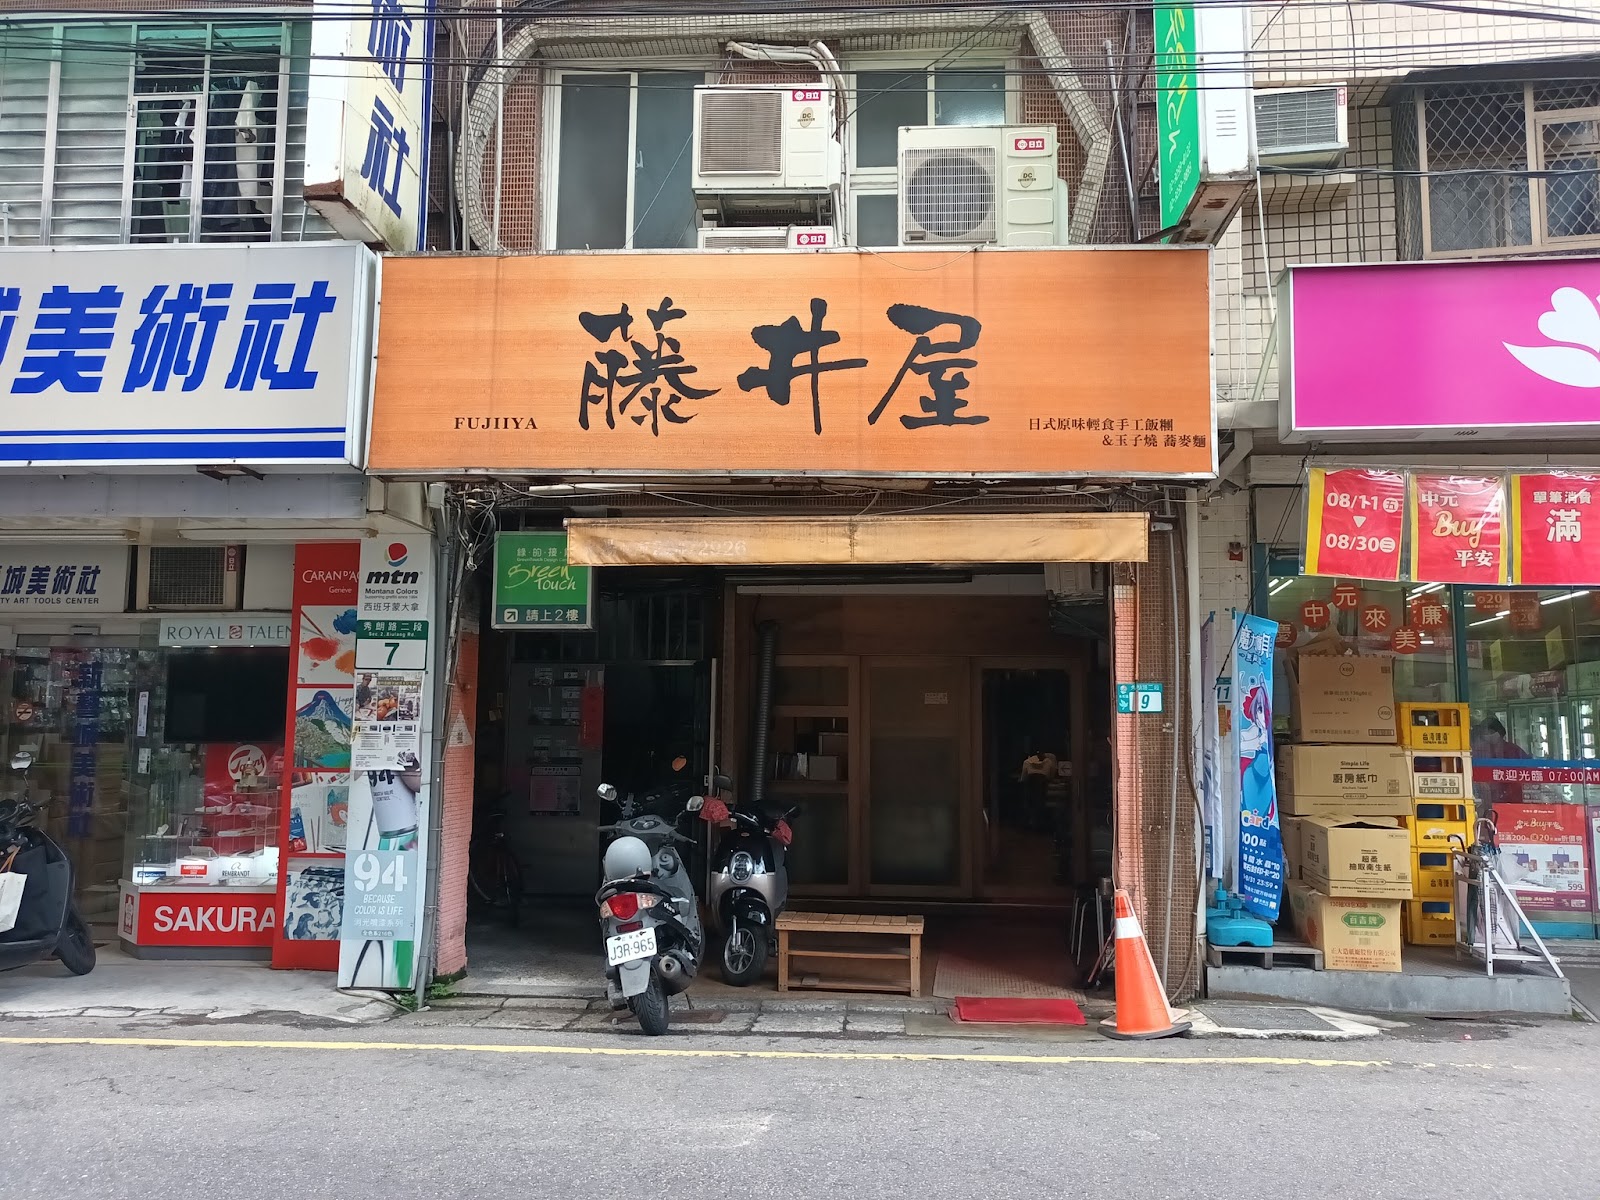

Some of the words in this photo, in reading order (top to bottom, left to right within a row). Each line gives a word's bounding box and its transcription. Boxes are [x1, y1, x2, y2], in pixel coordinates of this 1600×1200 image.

[0, 281, 337, 394] 美術社
[580, 297, 990, 435] 藤井屋
[454, 416, 538, 430] FUJIIYA
[1028, 417, 1174, 432] 日式原味輕食手工飯糰
[1421, 490, 1459, 507] 中元
[1533, 489, 1592, 504] 單筆消費
[1432, 510, 1486, 548] Buy
[1546, 508, 1582, 543] 滿
[1454, 549, 1494, 567] 平安
[0, 565, 101, 595] 城美術社
[366, 570, 419, 584] mtn
[534, 576, 577, 590] Touch
[363, 602, 420, 612] 西班牙蒙大拿
[526, 609, 579, 622] 請上2樓
[166, 626, 225, 640] ROYAL
[363, 621, 423, 631] 秀朗路二段
[384, 642, 400, 666] 7
[1216, 686, 1230, 700] 11
[1141, 694, 1151, 709] 9
[1333, 773, 1378, 783] 廚房紙巾
[1492, 769, 1543, 781] 歡迎光臨
[353, 853, 408, 892] 94
[363, 894, 396, 903] BECAUSE
[354, 905, 377, 915] COLOR
[378, 905, 386, 915] IS
[386, 905, 404, 916] LIFE
[153, 905, 276, 932] SAKURA
[1349, 914, 1378, 925] 百吉牌
